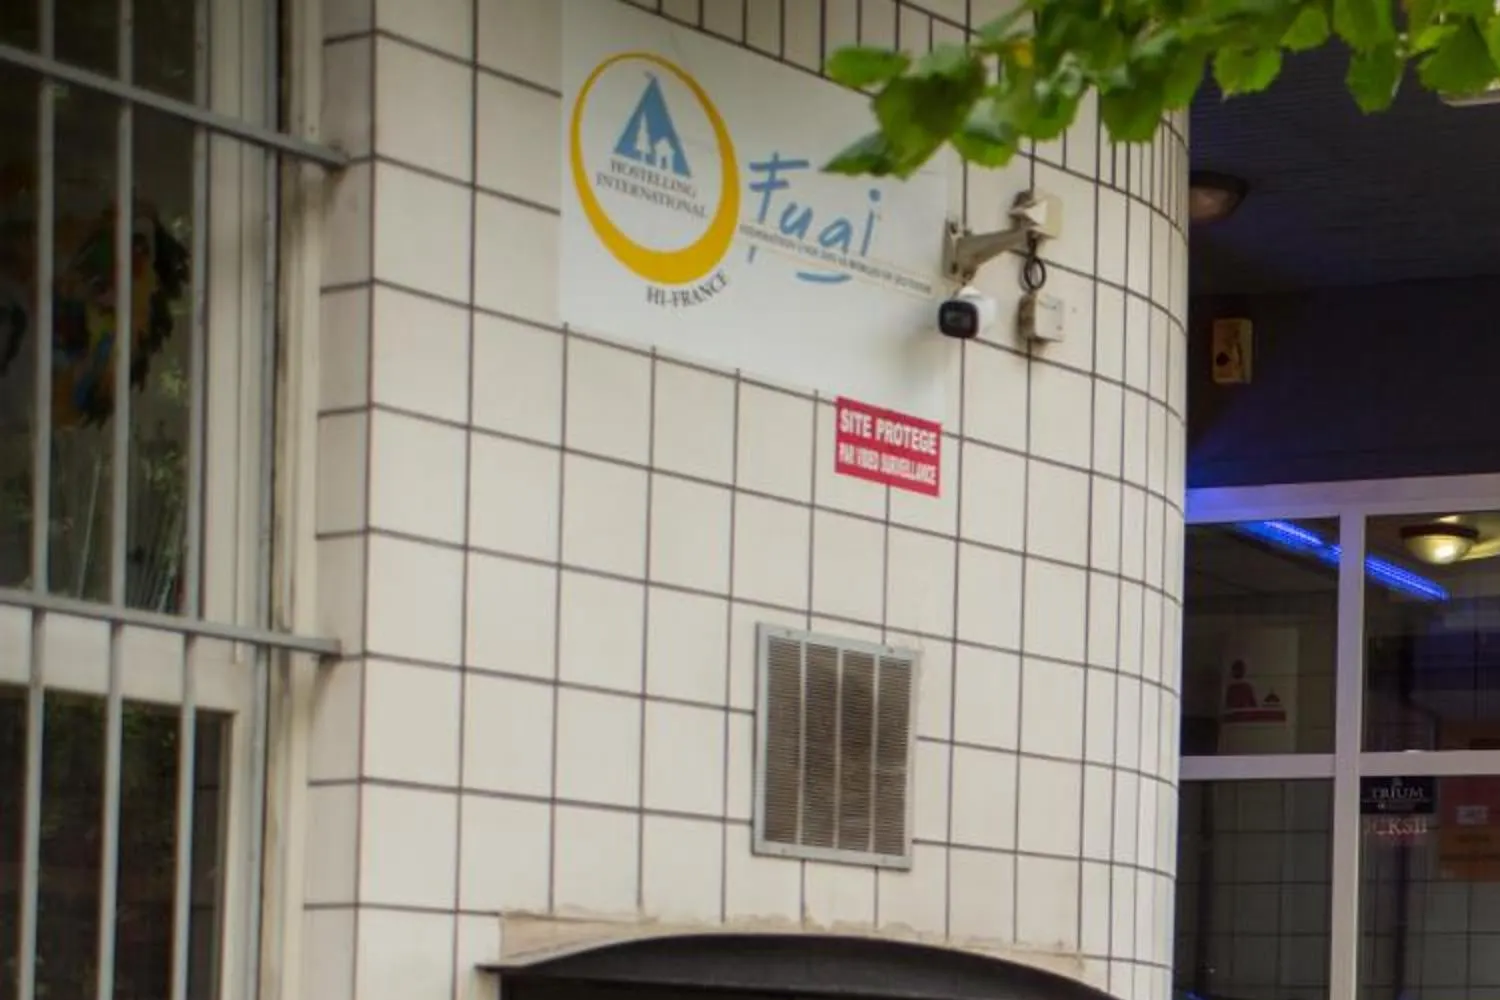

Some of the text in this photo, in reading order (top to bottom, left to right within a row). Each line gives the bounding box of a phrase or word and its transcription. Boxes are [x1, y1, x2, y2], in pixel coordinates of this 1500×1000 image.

[596, 172, 706, 218] INTERNATIONAL
[611, 158, 697, 199] HOSTELLING
[647, 270, 728, 308] HI-FRANCE
[840, 408, 938, 456] SITE PROTEGE
